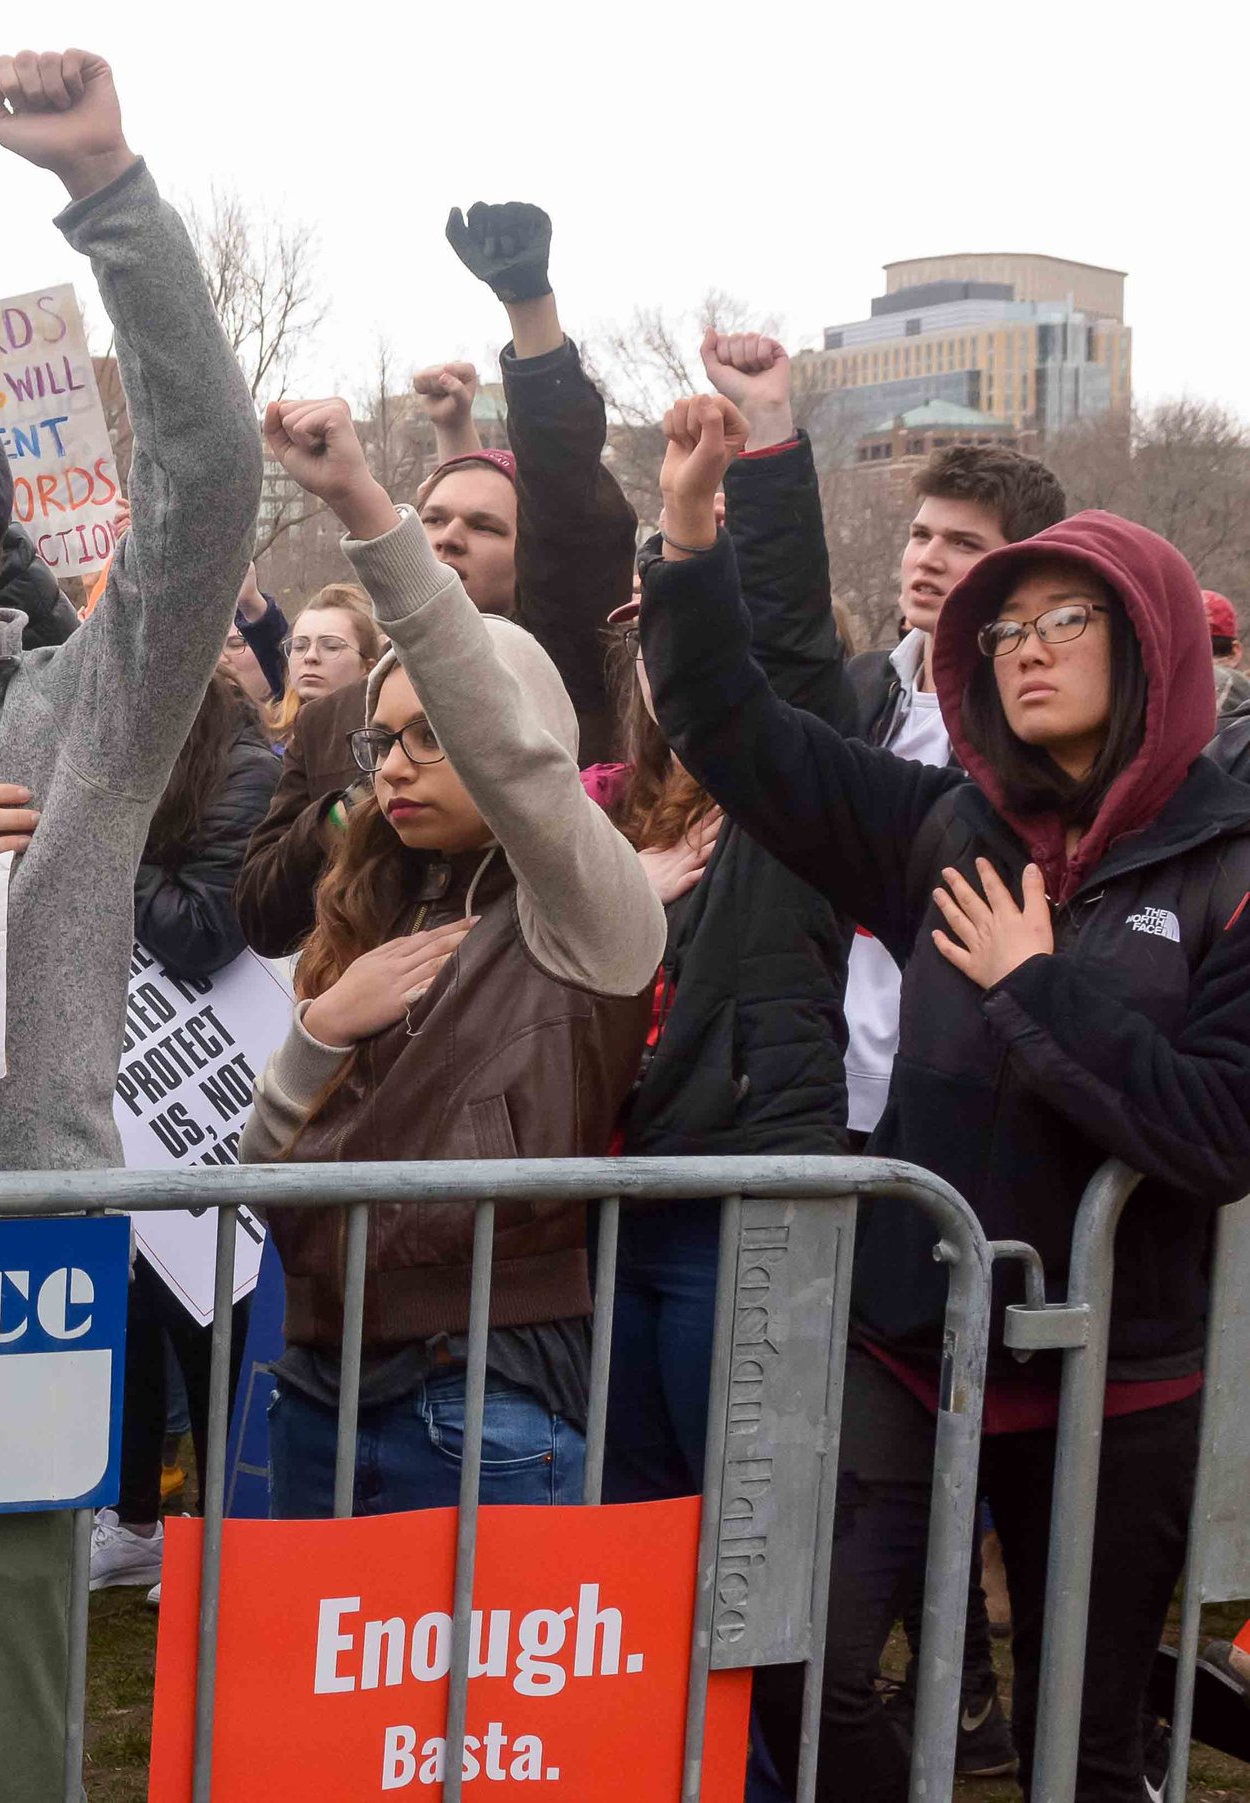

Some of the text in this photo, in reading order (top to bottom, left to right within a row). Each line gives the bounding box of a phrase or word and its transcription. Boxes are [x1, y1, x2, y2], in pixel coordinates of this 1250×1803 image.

[3, 356, 85, 402] WILL
[13, 457, 117, 523] ORDS
[35, 520, 117, 567] CTIO
[1125, 914, 1166, 927] NORTH
[1132, 922, 1163, 936] FACE
[1144, 906, 1168, 919] THE
[116, 1004, 236, 1117] PROTECT
[149, 1101, 218, 1159] US,
[198, 1052, 256, 1122] NOT
[313, 1583, 645, 1697] Enough.
[381, 1722, 561, 1791] Basta.
